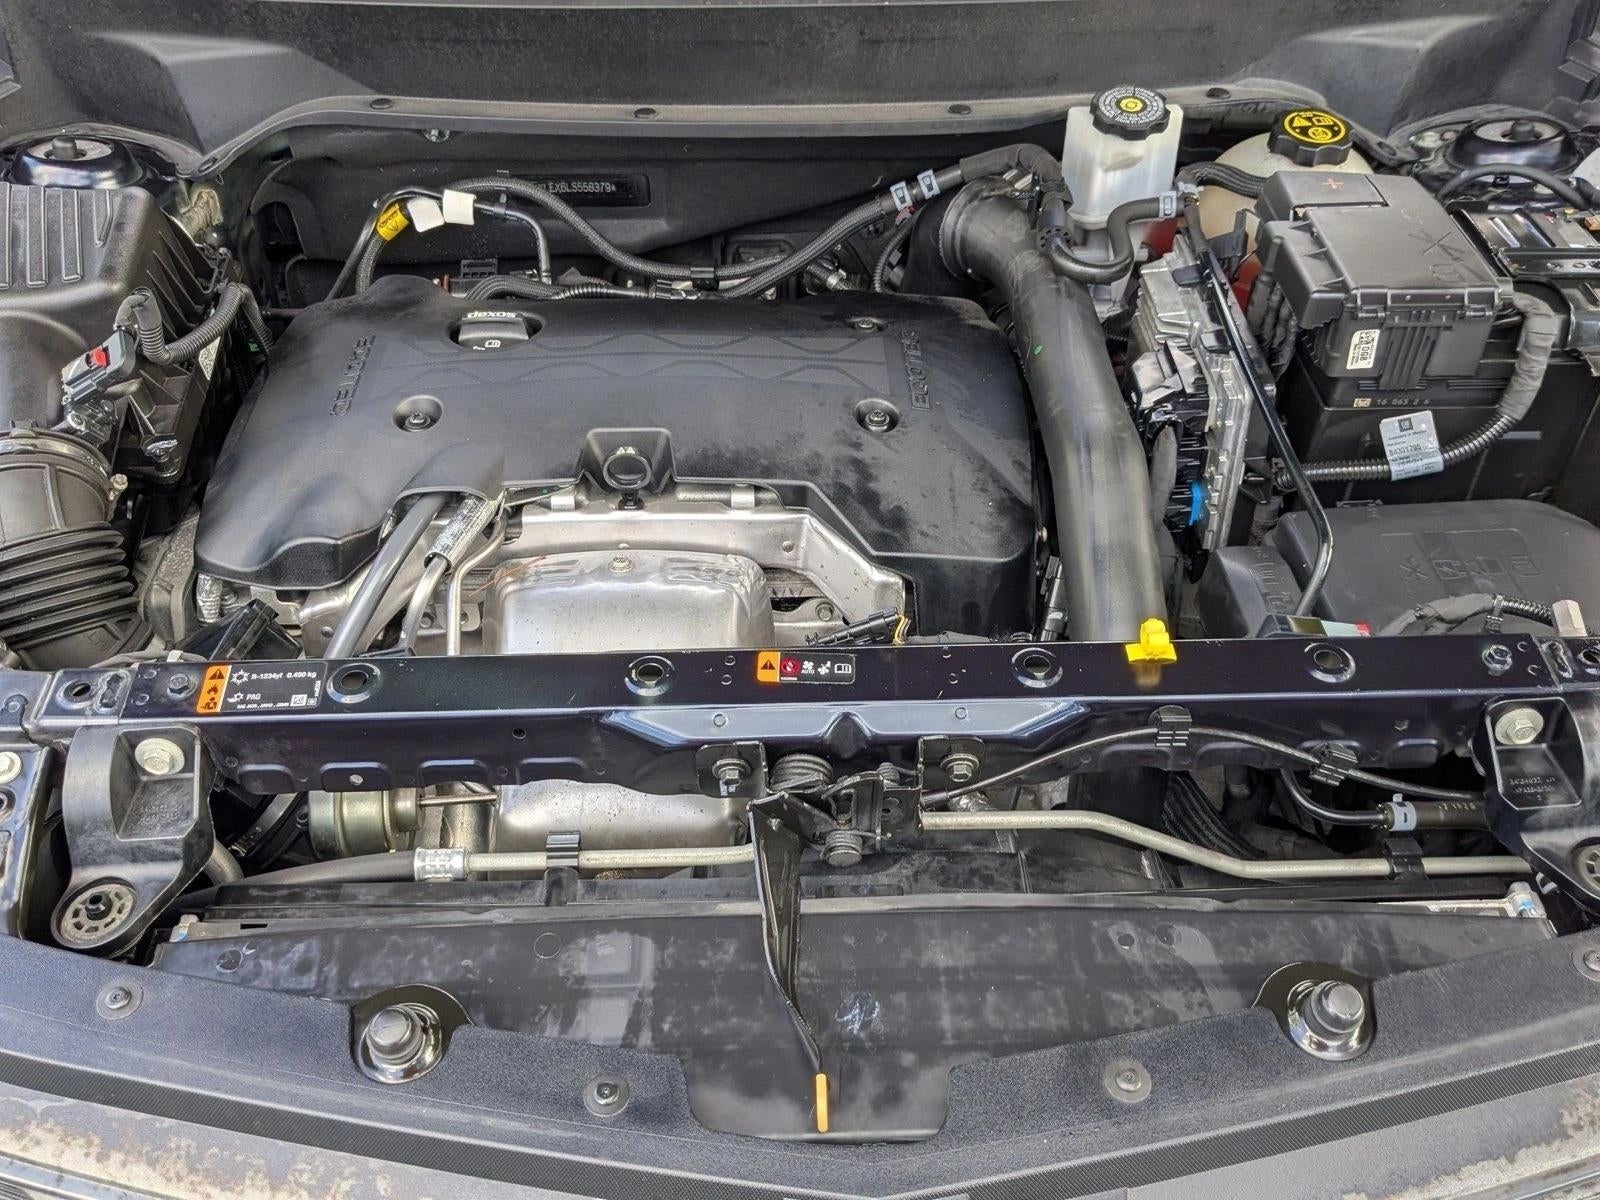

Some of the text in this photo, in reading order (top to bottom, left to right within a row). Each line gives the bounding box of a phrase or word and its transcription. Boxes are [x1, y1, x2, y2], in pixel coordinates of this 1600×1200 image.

[467, 311, 516, 319] dexos
[1360, 346, 1370, 362] DGB
[251, 673, 283, 681] R-1234yf
